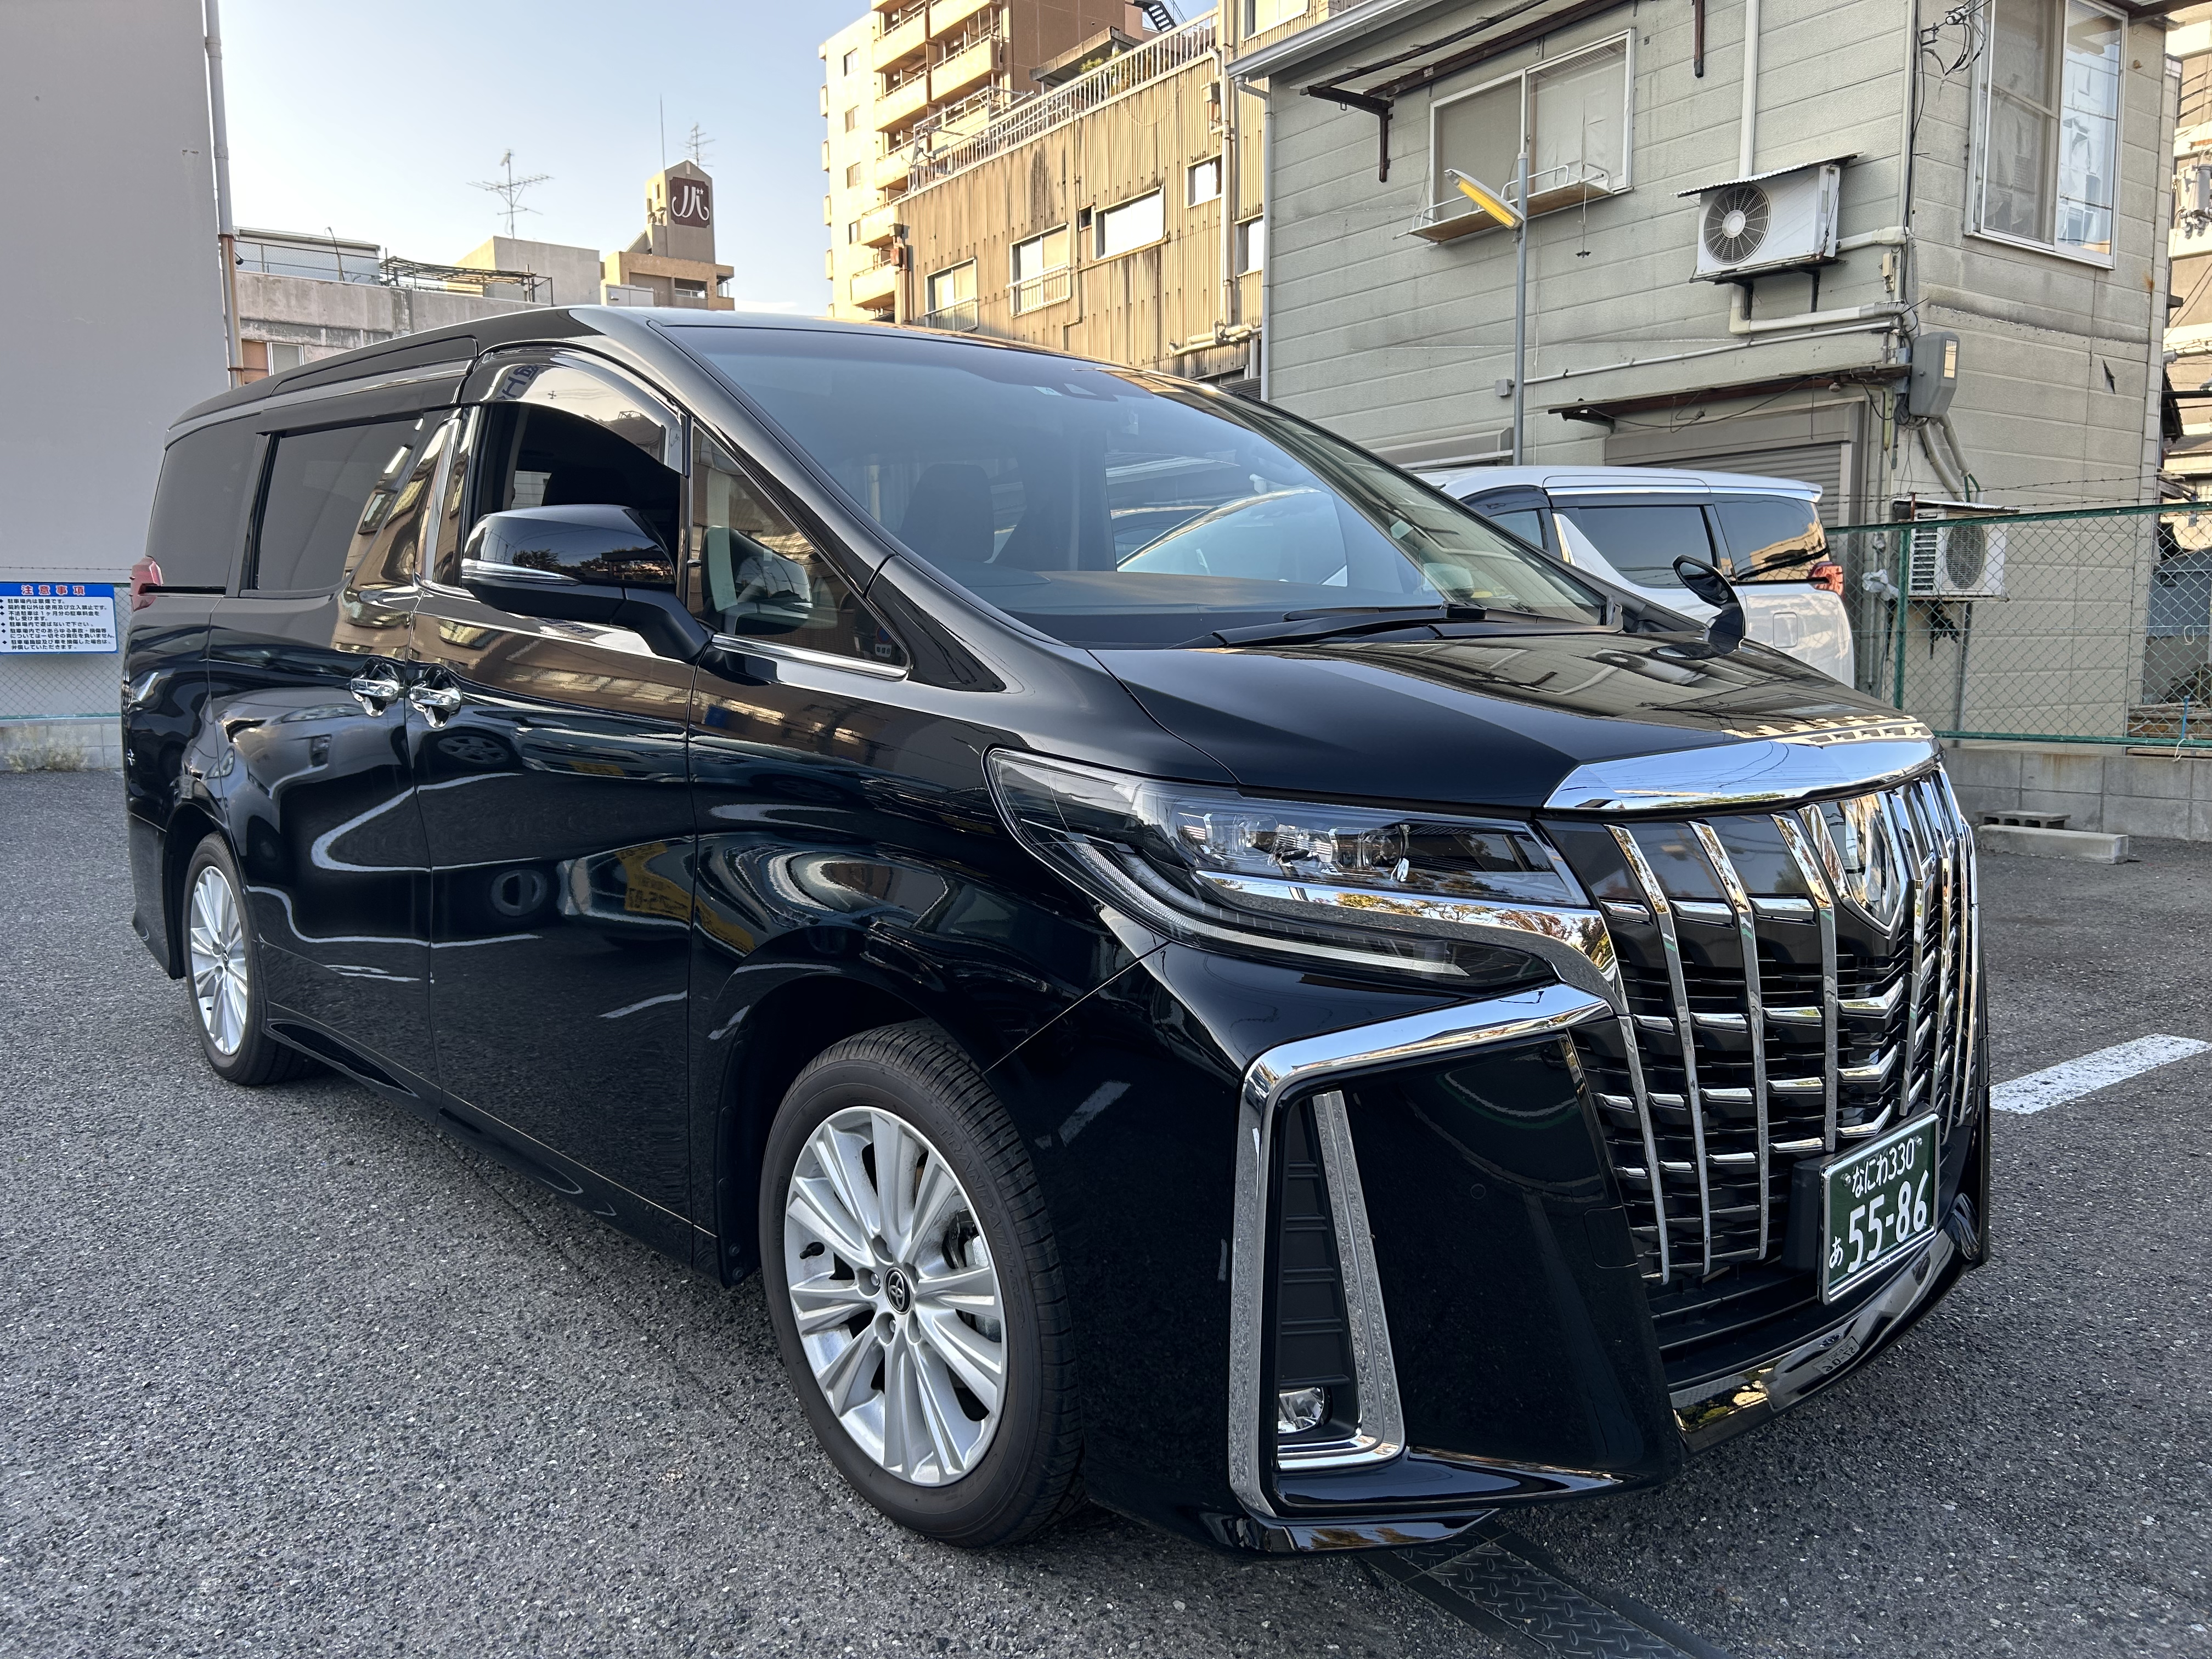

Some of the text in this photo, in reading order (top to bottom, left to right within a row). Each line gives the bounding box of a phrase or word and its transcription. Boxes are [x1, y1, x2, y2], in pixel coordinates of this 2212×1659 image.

[21, 584, 85, 596] 注意事項
[1829, 1170, 1929, 1273] あ 55-86
